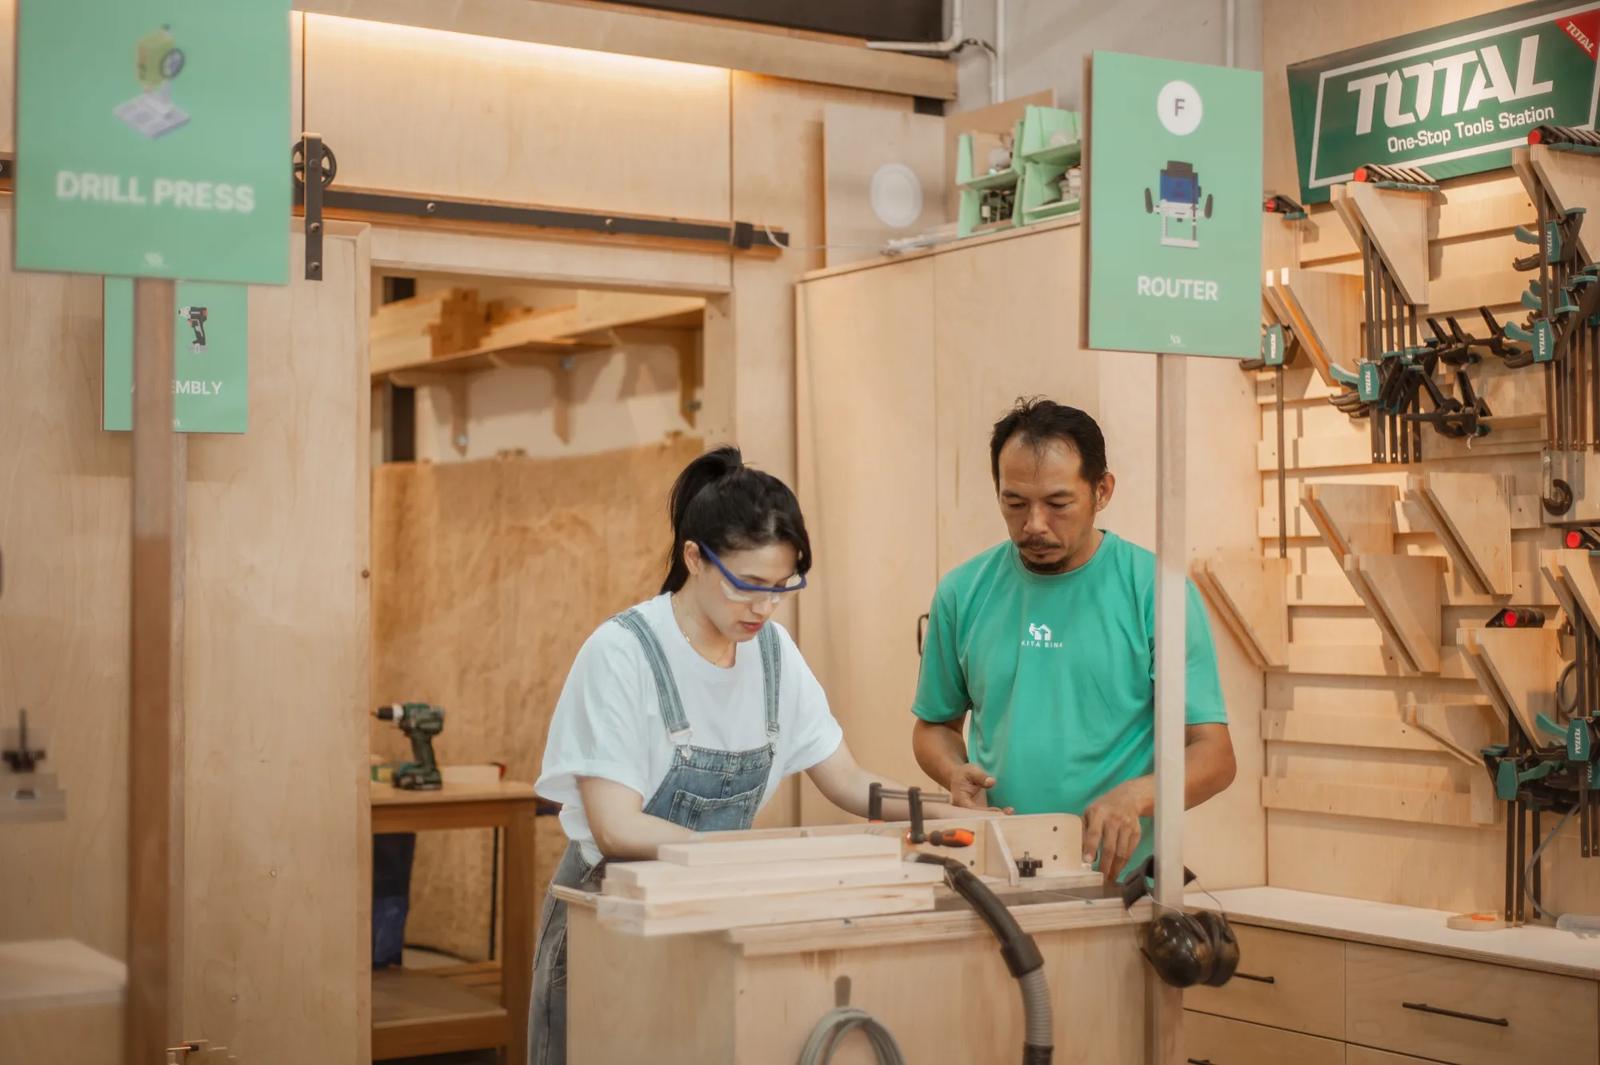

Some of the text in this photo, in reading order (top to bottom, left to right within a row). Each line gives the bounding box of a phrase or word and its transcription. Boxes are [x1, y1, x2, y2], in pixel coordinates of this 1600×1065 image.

[1565, 20, 1594, 53] TOTAL
[1347, 34, 1553, 136] TOTAL
[1174, 98, 1186, 117] F
[1387, 106, 1555, 153] One-Stop Tools Station
[56, 170, 255, 214] DRILL PRESS
[1137, 275, 1219, 301] ROUTER
